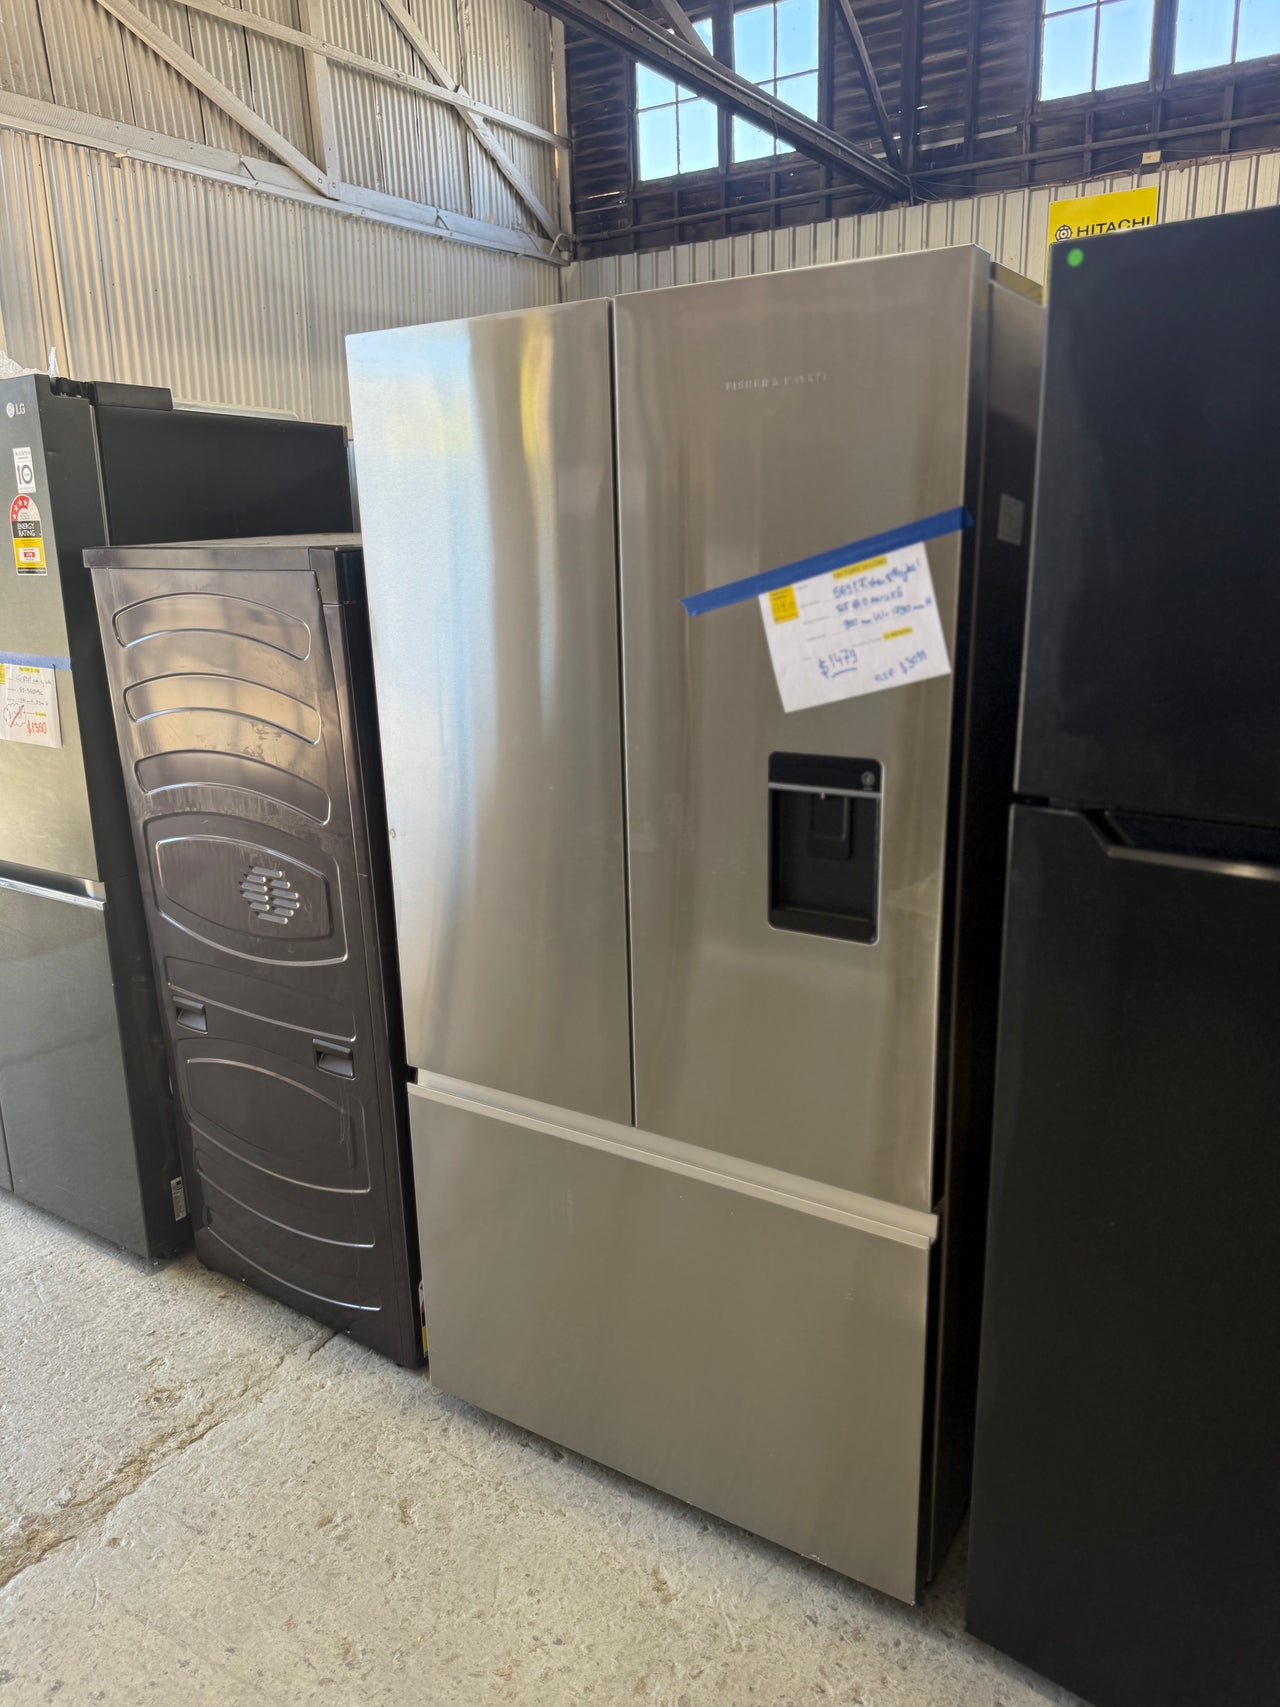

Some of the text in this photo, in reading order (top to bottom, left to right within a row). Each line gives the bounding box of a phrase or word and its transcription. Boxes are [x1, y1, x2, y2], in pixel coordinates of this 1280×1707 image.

[1077, 216, 1150, 237] HITACHI
[15, 403, 26, 414] LG
[17, 522, 35, 530] ENERGY
[818, 648, 859, 679] $1479
[26, 719, 48, 736] $1350
